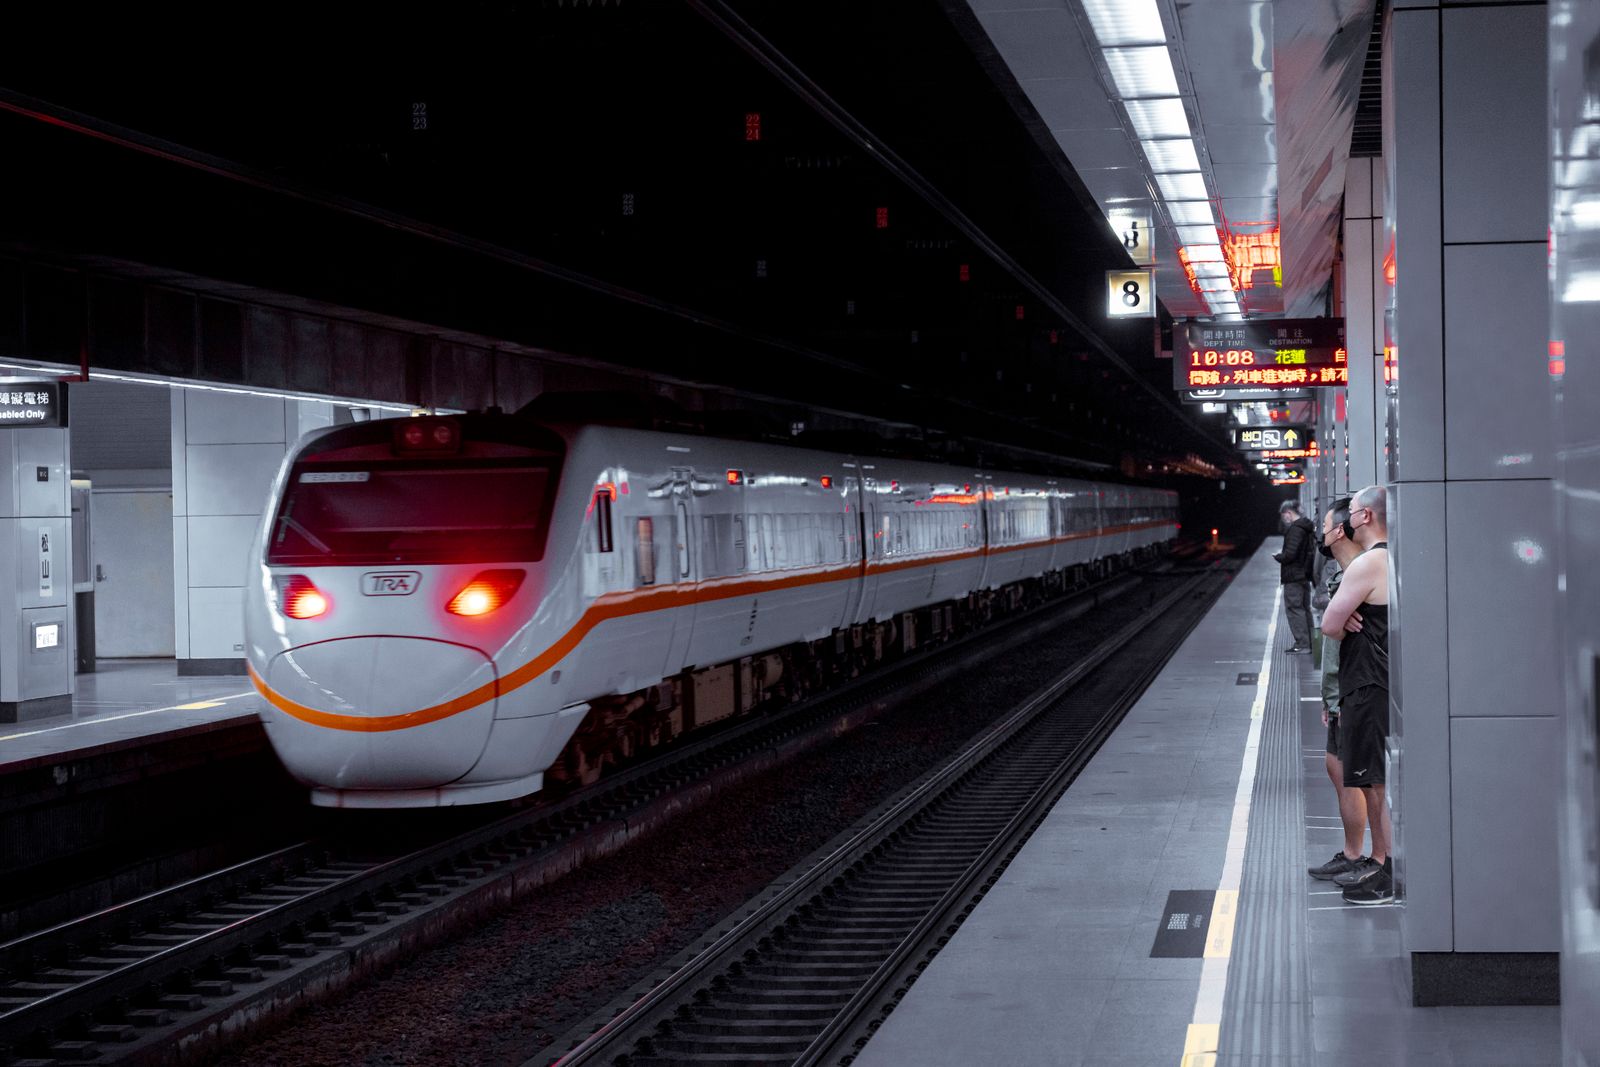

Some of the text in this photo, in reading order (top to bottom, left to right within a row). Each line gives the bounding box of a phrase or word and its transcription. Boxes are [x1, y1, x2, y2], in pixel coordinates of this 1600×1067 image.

[412, 103, 426, 115] 22
[412, 117, 427, 130] 23
[745, 114, 760, 126] 22
[745, 128, 760, 141] 24
[622, 194, 634, 204] 22
[1122, 280, 1140, 307] 8
[1269, 338, 1313, 346] DESTINATION
[1191, 350, 1254, 366] 10:08
[1275, 349, 1306, 365] 花蓮
[26, 409, 46, 420] Only
[1242, 430, 1262, 442] 出口
[371, 575, 410, 592] TRA
